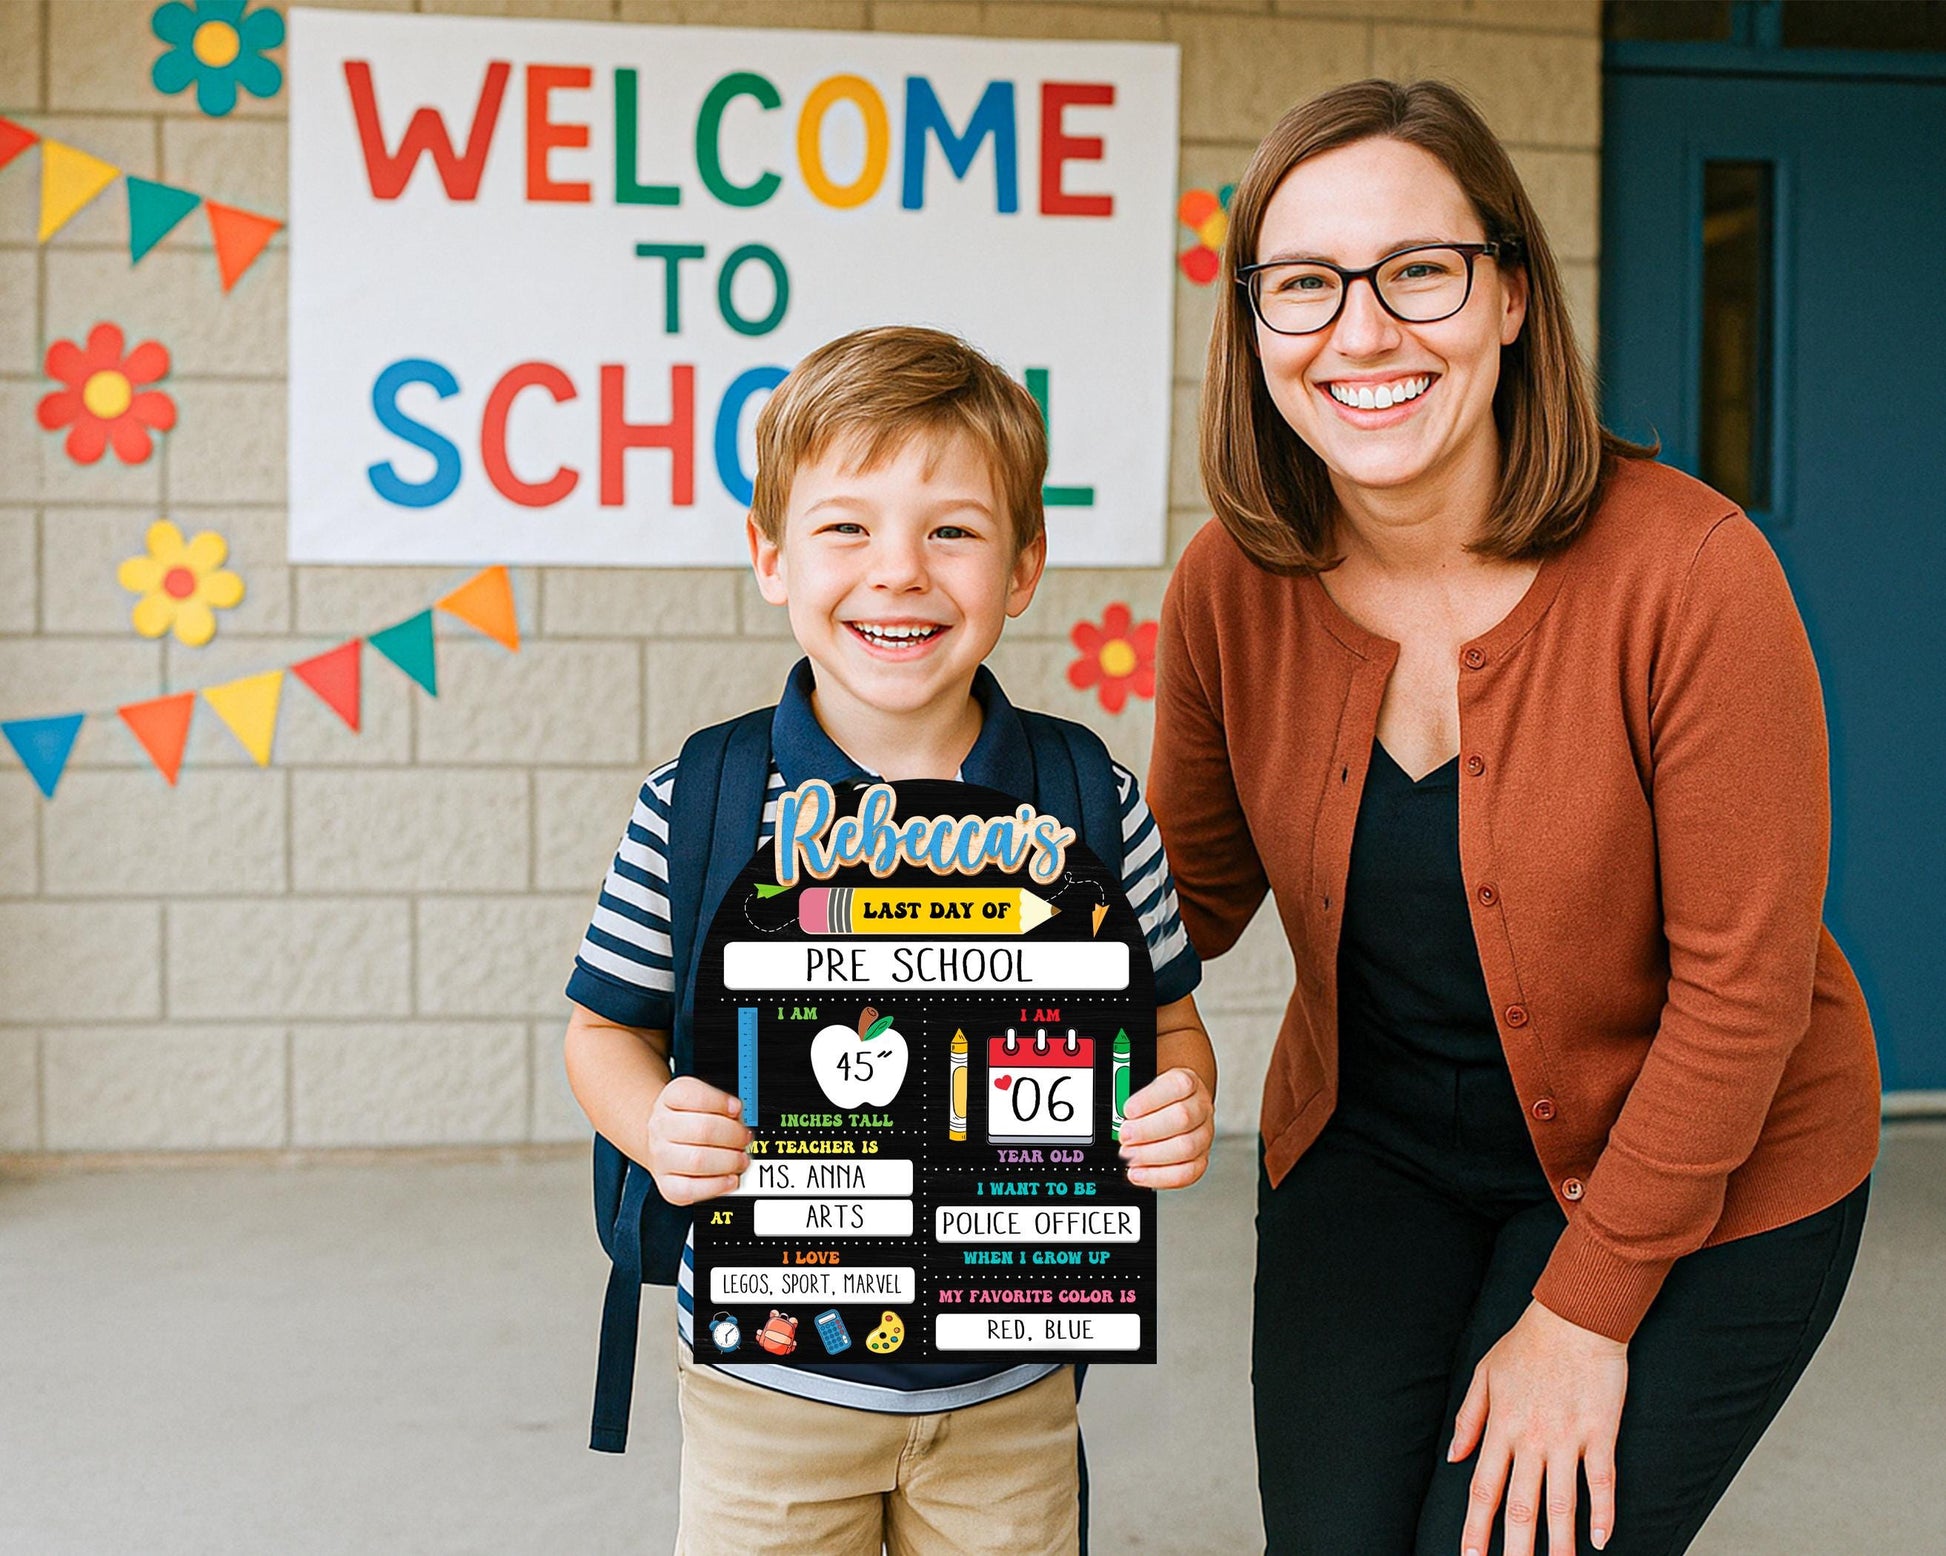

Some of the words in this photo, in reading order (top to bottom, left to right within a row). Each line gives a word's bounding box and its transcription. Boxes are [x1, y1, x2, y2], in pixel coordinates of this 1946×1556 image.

[342, 59, 1117, 219] WELCOME
[635, 243, 789, 337] TO
[783, 784, 1069, 880] Rebecca's
[863, 901, 922, 920] LAST
[929, 901, 975, 920] DAY
[981, 901, 1012, 920] OF
[806, 947, 870, 982] PRE
[891, 947, 1033, 983] SCHOOL
[777, 1006, 785, 1020] I
[790, 1006, 818, 1020] AM
[1020, 1008, 1028, 1023] I
[1032, 1008, 1061, 1023] AM
[1011, 1075, 1075, 1122] 06
[780, 1113, 843, 1128] INCHES
[848, 1113, 894, 1128] TALL
[774, 1140, 856, 1154] TEACHER
[861, 1140, 879, 1154] IS
[997, 1149, 1044, 1163] YEAR
[1049, 1149, 1085, 1163] OLD
[759, 1164, 795, 1189] MS.
[806, 1164, 866, 1189] ANNA
[977, 1182, 984, 1196] I
[989, 1182, 1040, 1196] WANT
[1045, 1182, 1068, 1196] TO
[1073, 1182, 1097, 1196] BE
[710, 1211, 734, 1225] AT
[805, 1204, 864, 1229] ARTS
[943, 1211, 1021, 1235] POLICE
[1034, 1211, 1133, 1235] OFFICER
[782, 1251, 789, 1265] I
[795, 1250, 840, 1265] LOVE
[963, 1251, 1014, 1265] WHEN
[1019, 1251, 1027, 1265] I
[1032, 1251, 1082, 1265] GROW
[1088, 1251, 1111, 1265] UP
[723, 1273, 773, 1296] LEGOS,
[781, 1273, 836, 1296] SPORT,
[843, 1273, 902, 1294] MARVEL
[938, 1289, 963, 1304] MY
[969, 1289, 1053, 1304] FAVORITE
[1058, 1289, 1113, 1304] COLOR
[1119, 1289, 1137, 1304] IS
[987, 1319, 1033, 1342] RED,
[1045, 1319, 1094, 1340] BLUE
